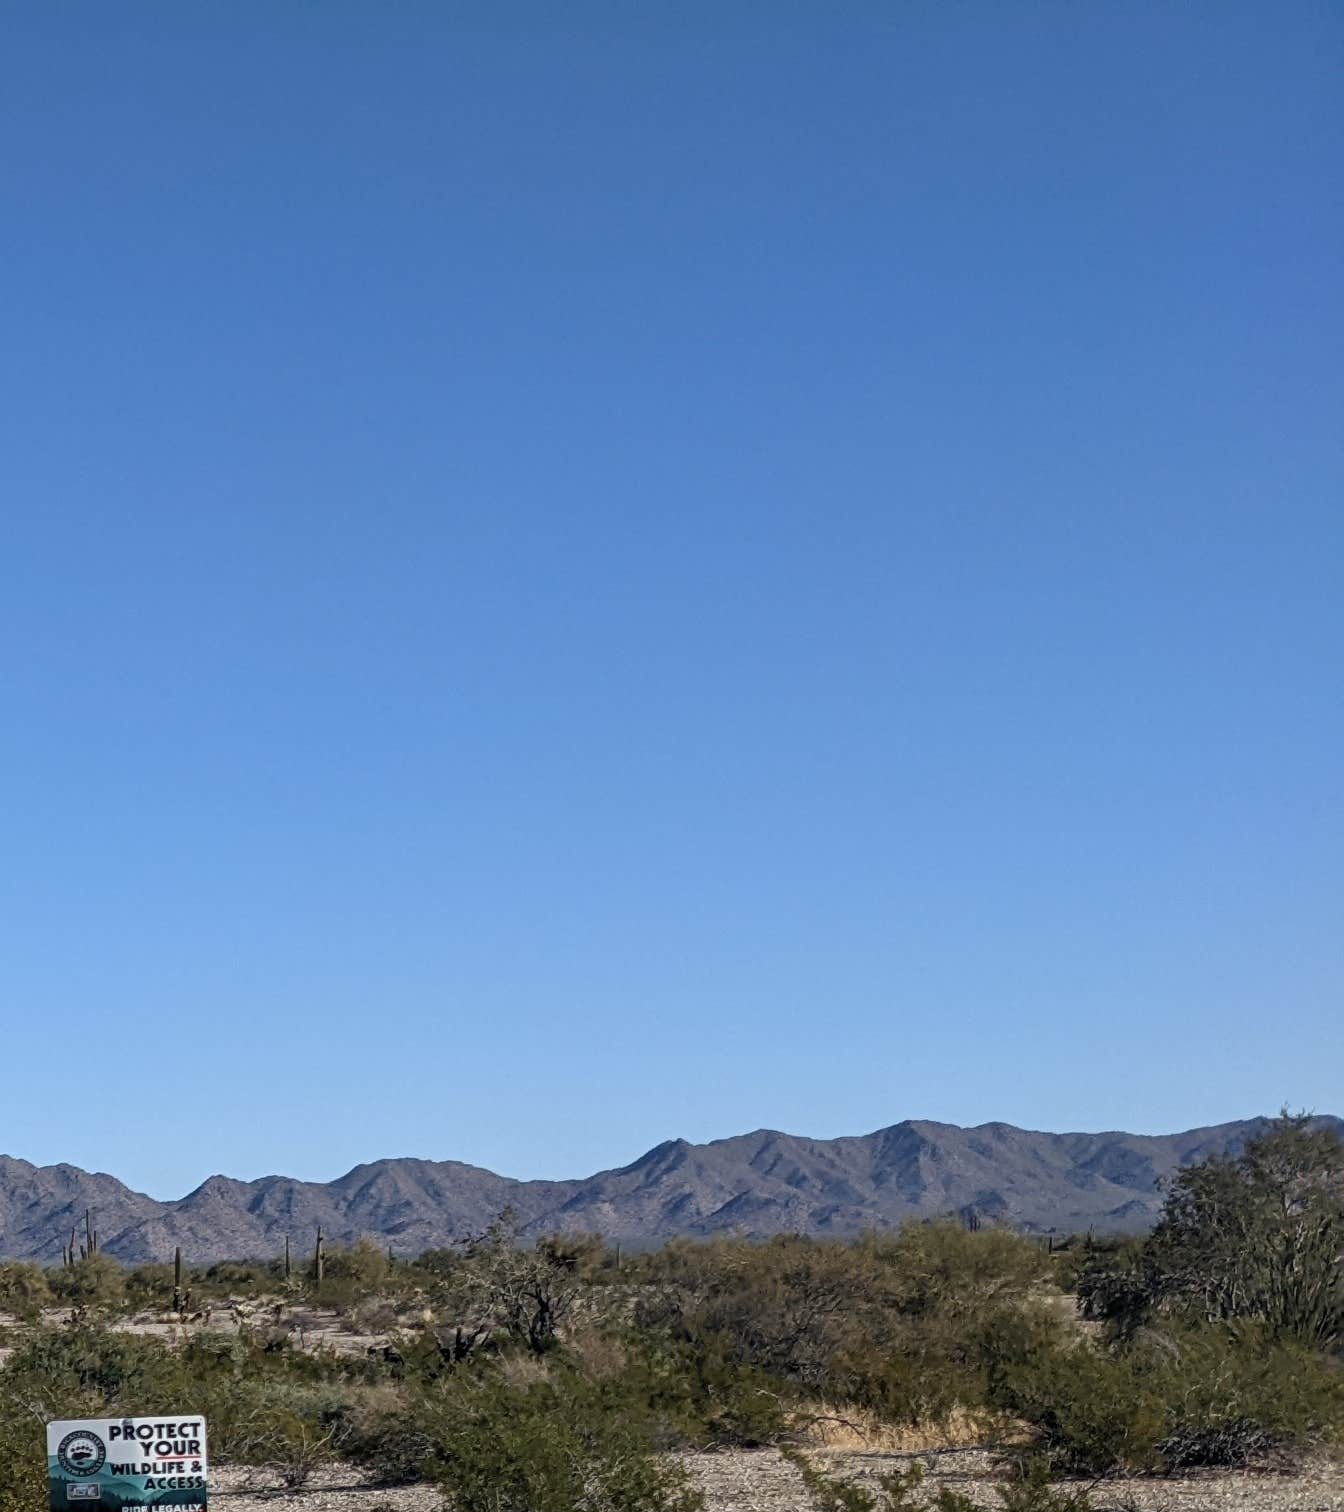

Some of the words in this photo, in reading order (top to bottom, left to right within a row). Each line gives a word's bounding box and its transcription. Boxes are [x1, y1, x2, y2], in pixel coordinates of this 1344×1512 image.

[109, 1422, 200, 1441] PROTECT
[140, 1440, 200, 1456] YOUR
[111, 1462, 184, 1475] WILDLIFE
[191, 1461, 202, 1473] &
[144, 1476, 202, 1490] ACCESS
